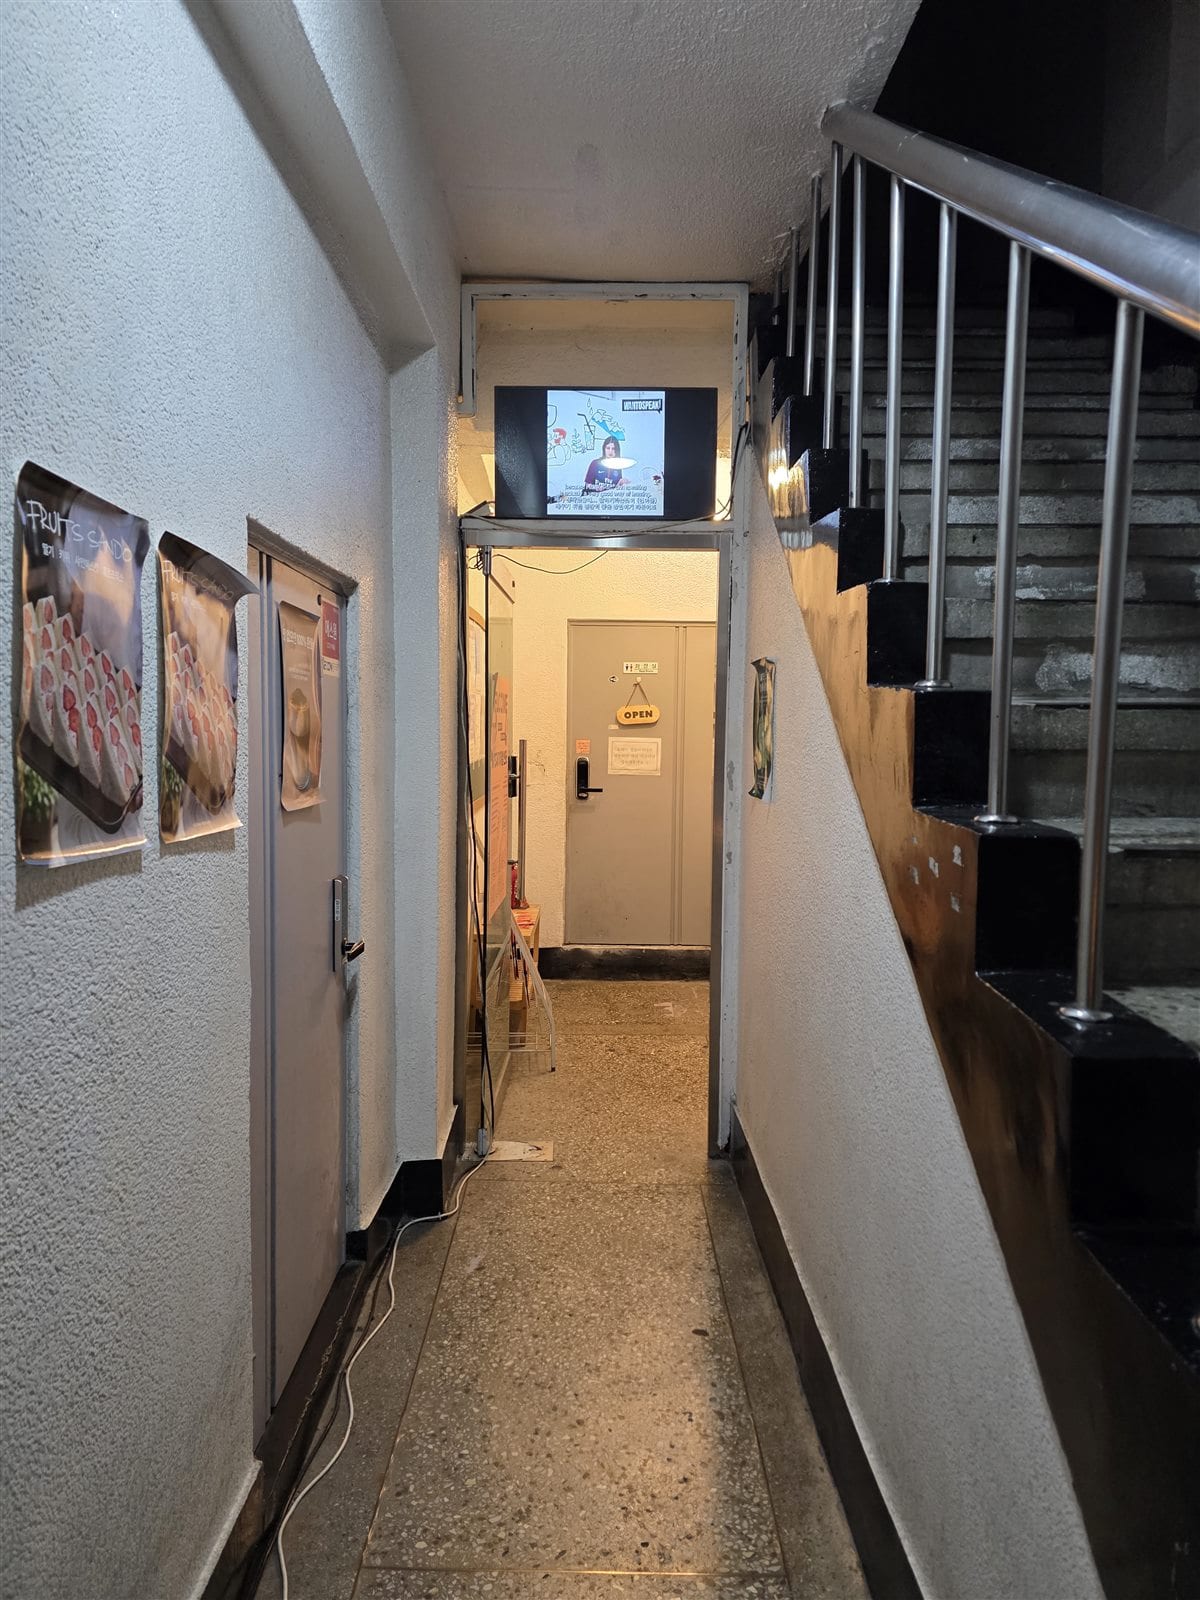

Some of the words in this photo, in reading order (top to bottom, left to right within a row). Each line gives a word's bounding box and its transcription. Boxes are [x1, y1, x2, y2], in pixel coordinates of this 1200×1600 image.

[26, 500, 84, 542] FRUITS
[87, 526, 132, 562] SANDO
[623, 710, 653, 720] OPEN
